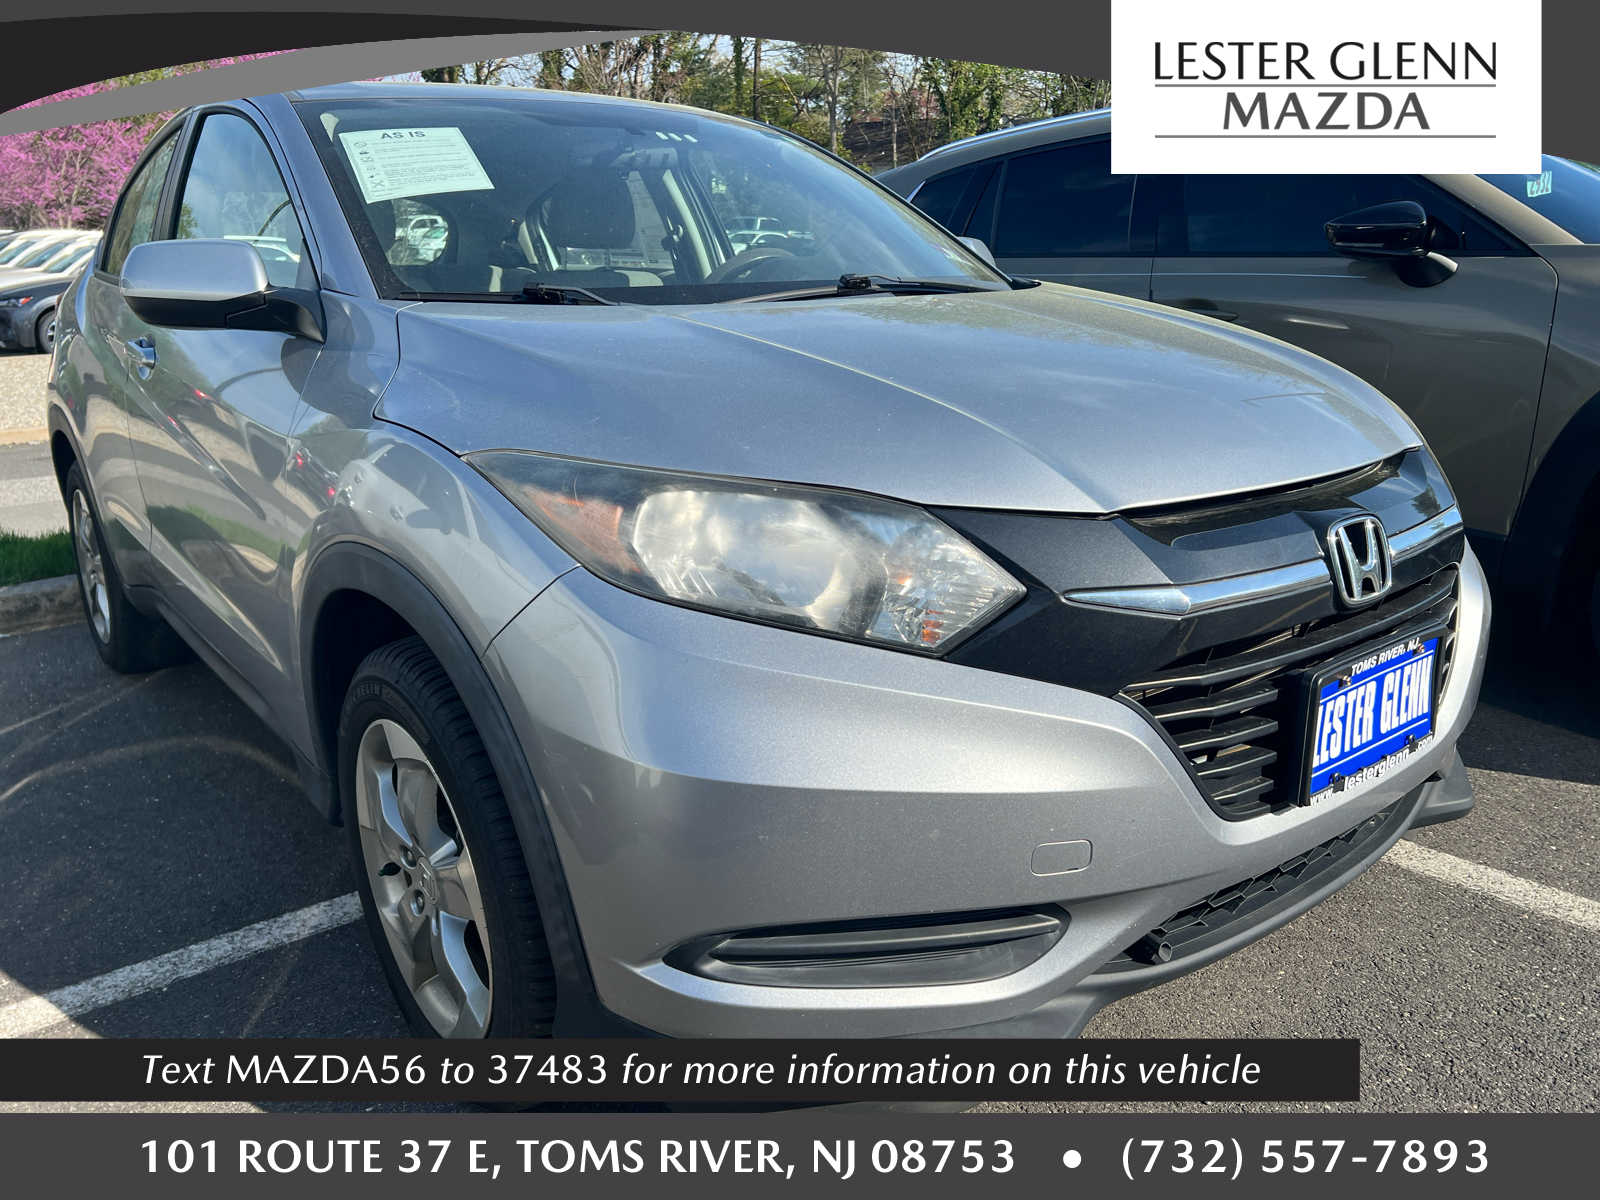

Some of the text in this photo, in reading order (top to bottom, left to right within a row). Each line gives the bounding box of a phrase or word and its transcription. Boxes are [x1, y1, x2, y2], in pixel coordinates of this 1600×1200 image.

[381, 130, 427, 140] AS IS
[1351, 655, 1378, 677] TOMS
[1377, 643, 1406, 666] RIVER,
[1312, 654, 1433, 769] LESTER GLENN
